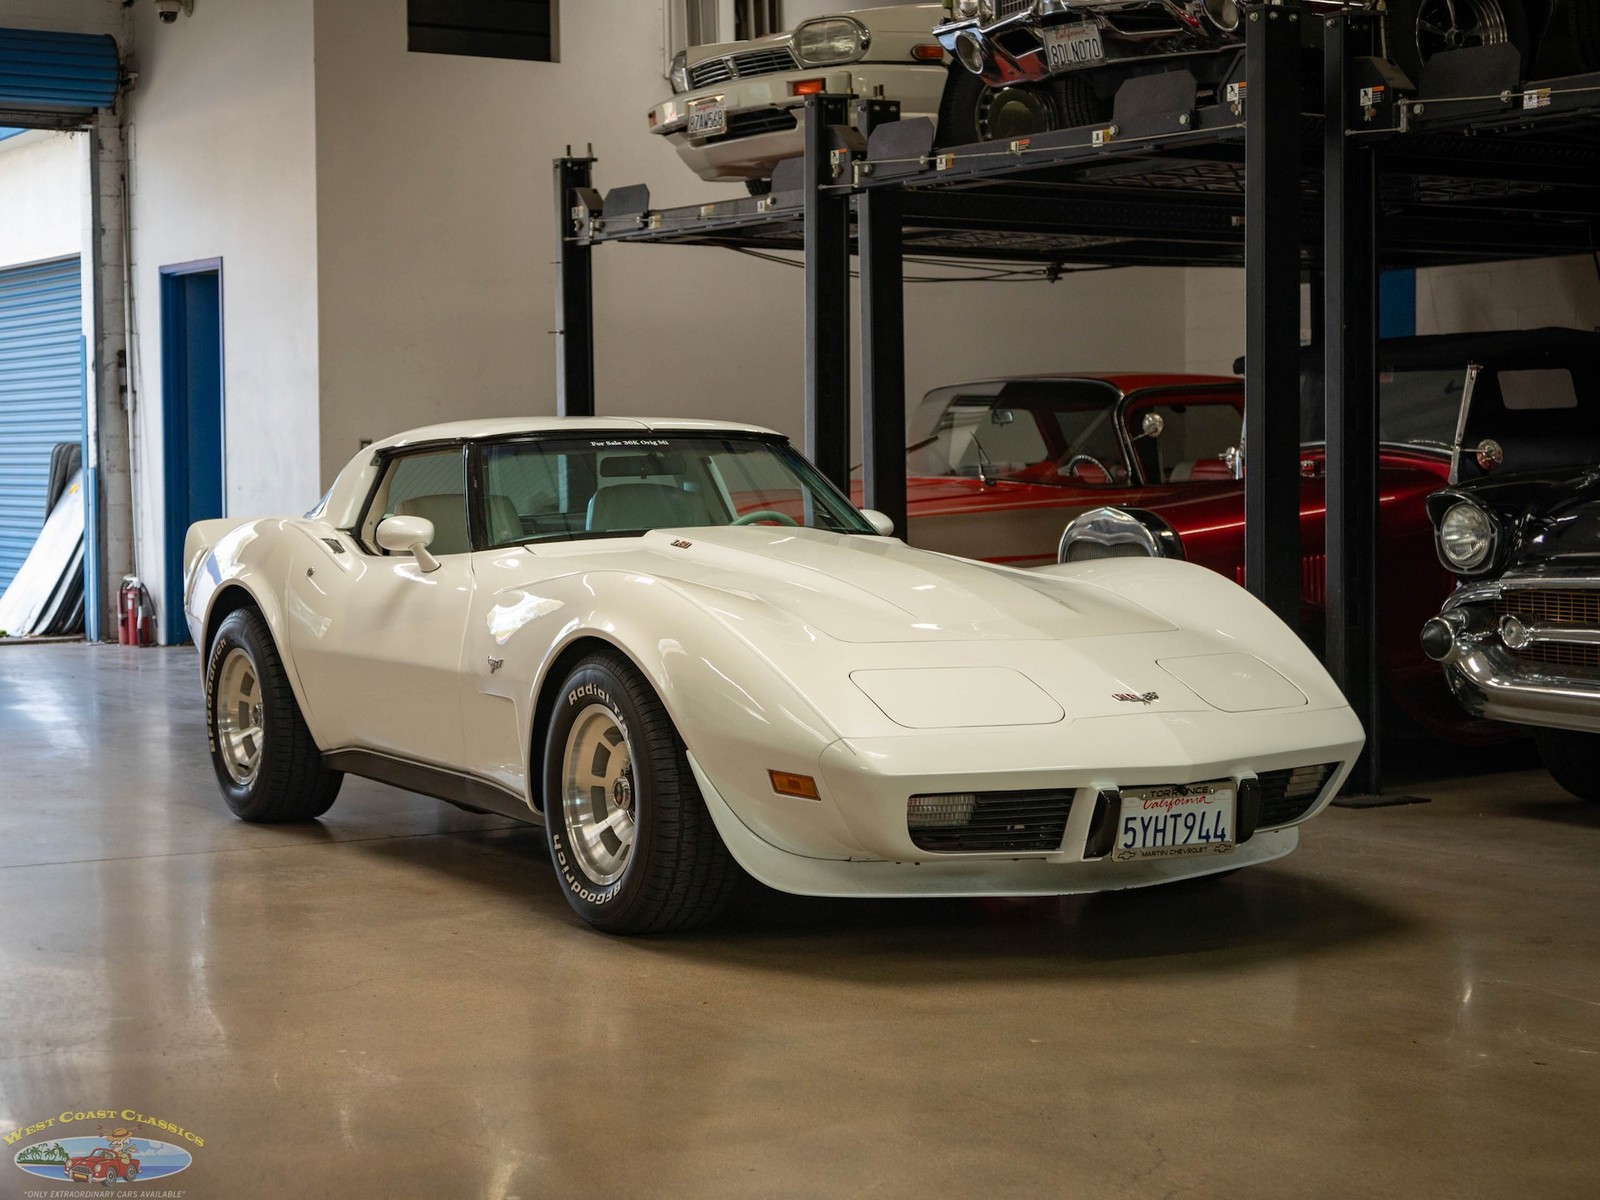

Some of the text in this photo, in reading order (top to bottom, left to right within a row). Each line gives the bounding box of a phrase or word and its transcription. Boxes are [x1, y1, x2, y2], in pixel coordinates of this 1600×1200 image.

[1050, 38, 1101, 65] 8DLN070
[568, 683, 609, 706] Radial
[1143, 795, 1214, 813] California
[1123, 810, 1226, 849] 5YHT944
[1170, 846, 1208, 855] CHEVROLET
[553, 834, 621, 905] BFGoodrich
